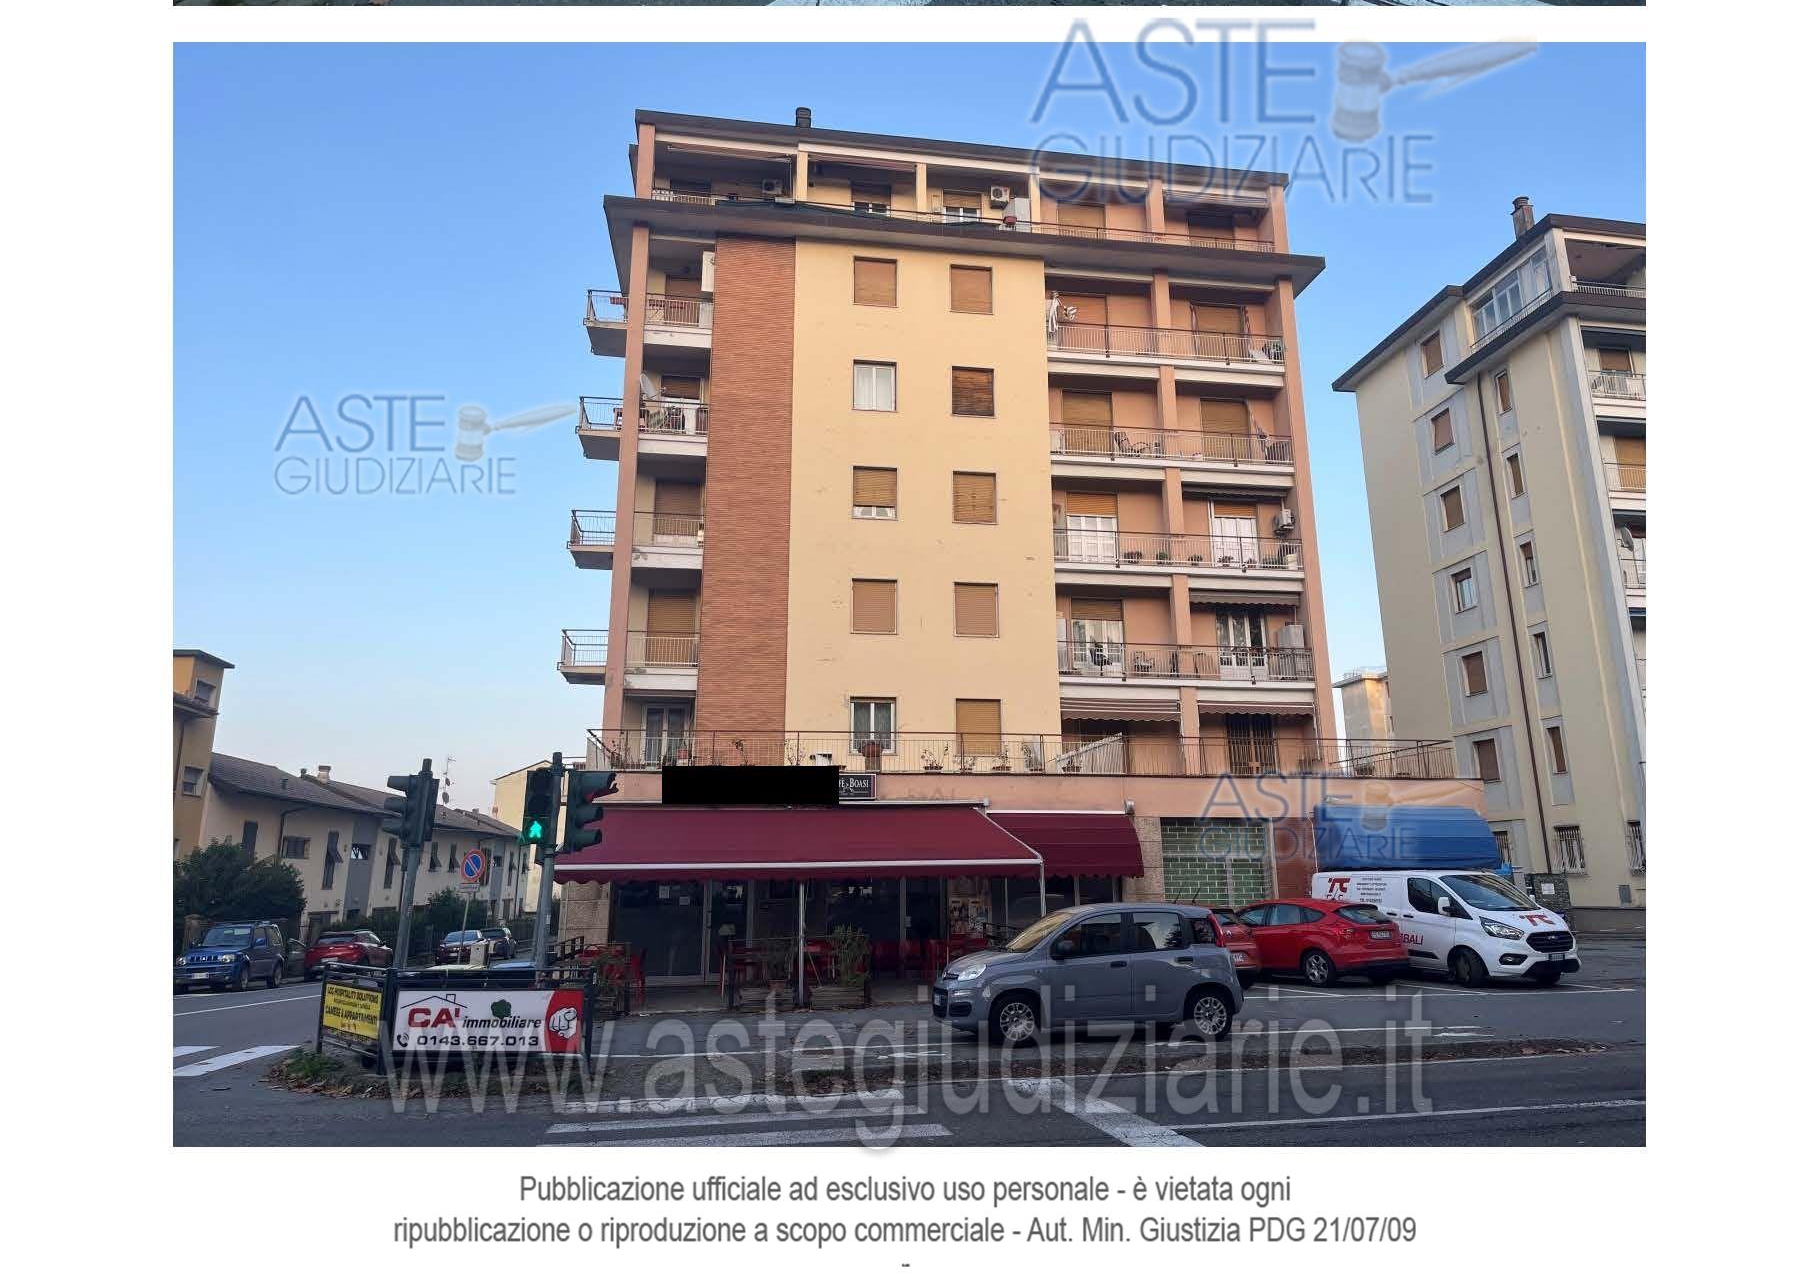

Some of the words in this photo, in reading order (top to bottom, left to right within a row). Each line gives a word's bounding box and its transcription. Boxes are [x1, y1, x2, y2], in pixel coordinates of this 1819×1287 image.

[1401, 932, 1424, 945] BALI
[408, 1007, 460, 1028] CA'
[462, 1016, 542, 1029] immobiliare
[417, 1036, 539, 1046] 0143.667.013
